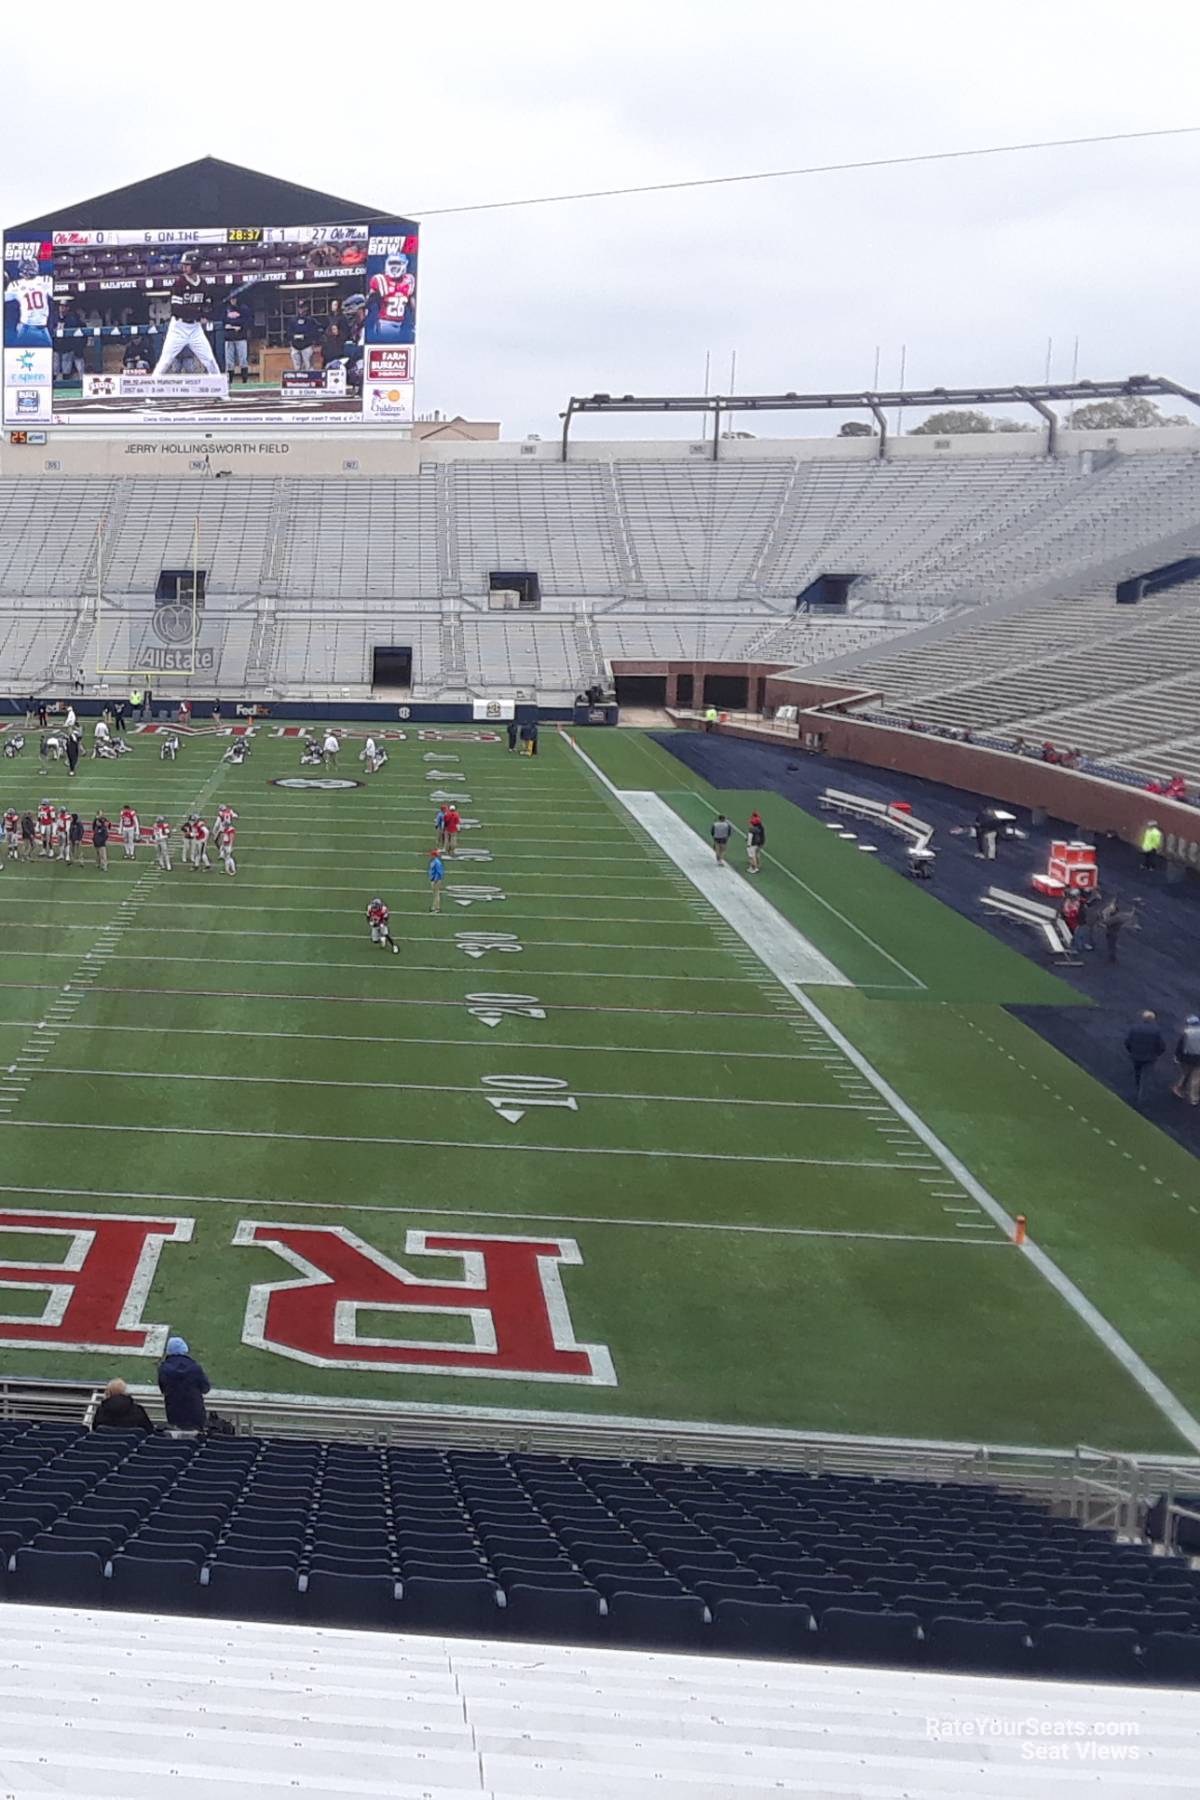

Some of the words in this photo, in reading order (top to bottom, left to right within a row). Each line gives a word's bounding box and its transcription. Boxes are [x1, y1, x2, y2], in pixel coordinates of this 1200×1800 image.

[158, 232, 174, 242] ON
[178, 231, 199, 241] THE
[312, 229, 326, 240] 27
[24, 291, 44, 311] 10
[386, 296, 408, 316] 26
[382, 352, 407, 361] FARM
[371, 360, 407, 370] BUREAU
[11, 431, 26, 444] 25
[125, 444, 157, 454] JERRY
[161, 444, 256, 454] HOLLINGSWORTH
[259, 443, 290, 454] FIELD
[141, 648, 212, 669] Allstate
[236, 704, 272, 716] FedEx
[1075, 872, 1090, 886] G
[454, 930, 524, 953] 30
[463, 991, 548, 1020] 20
[480, 1073, 580, 1112] 10
